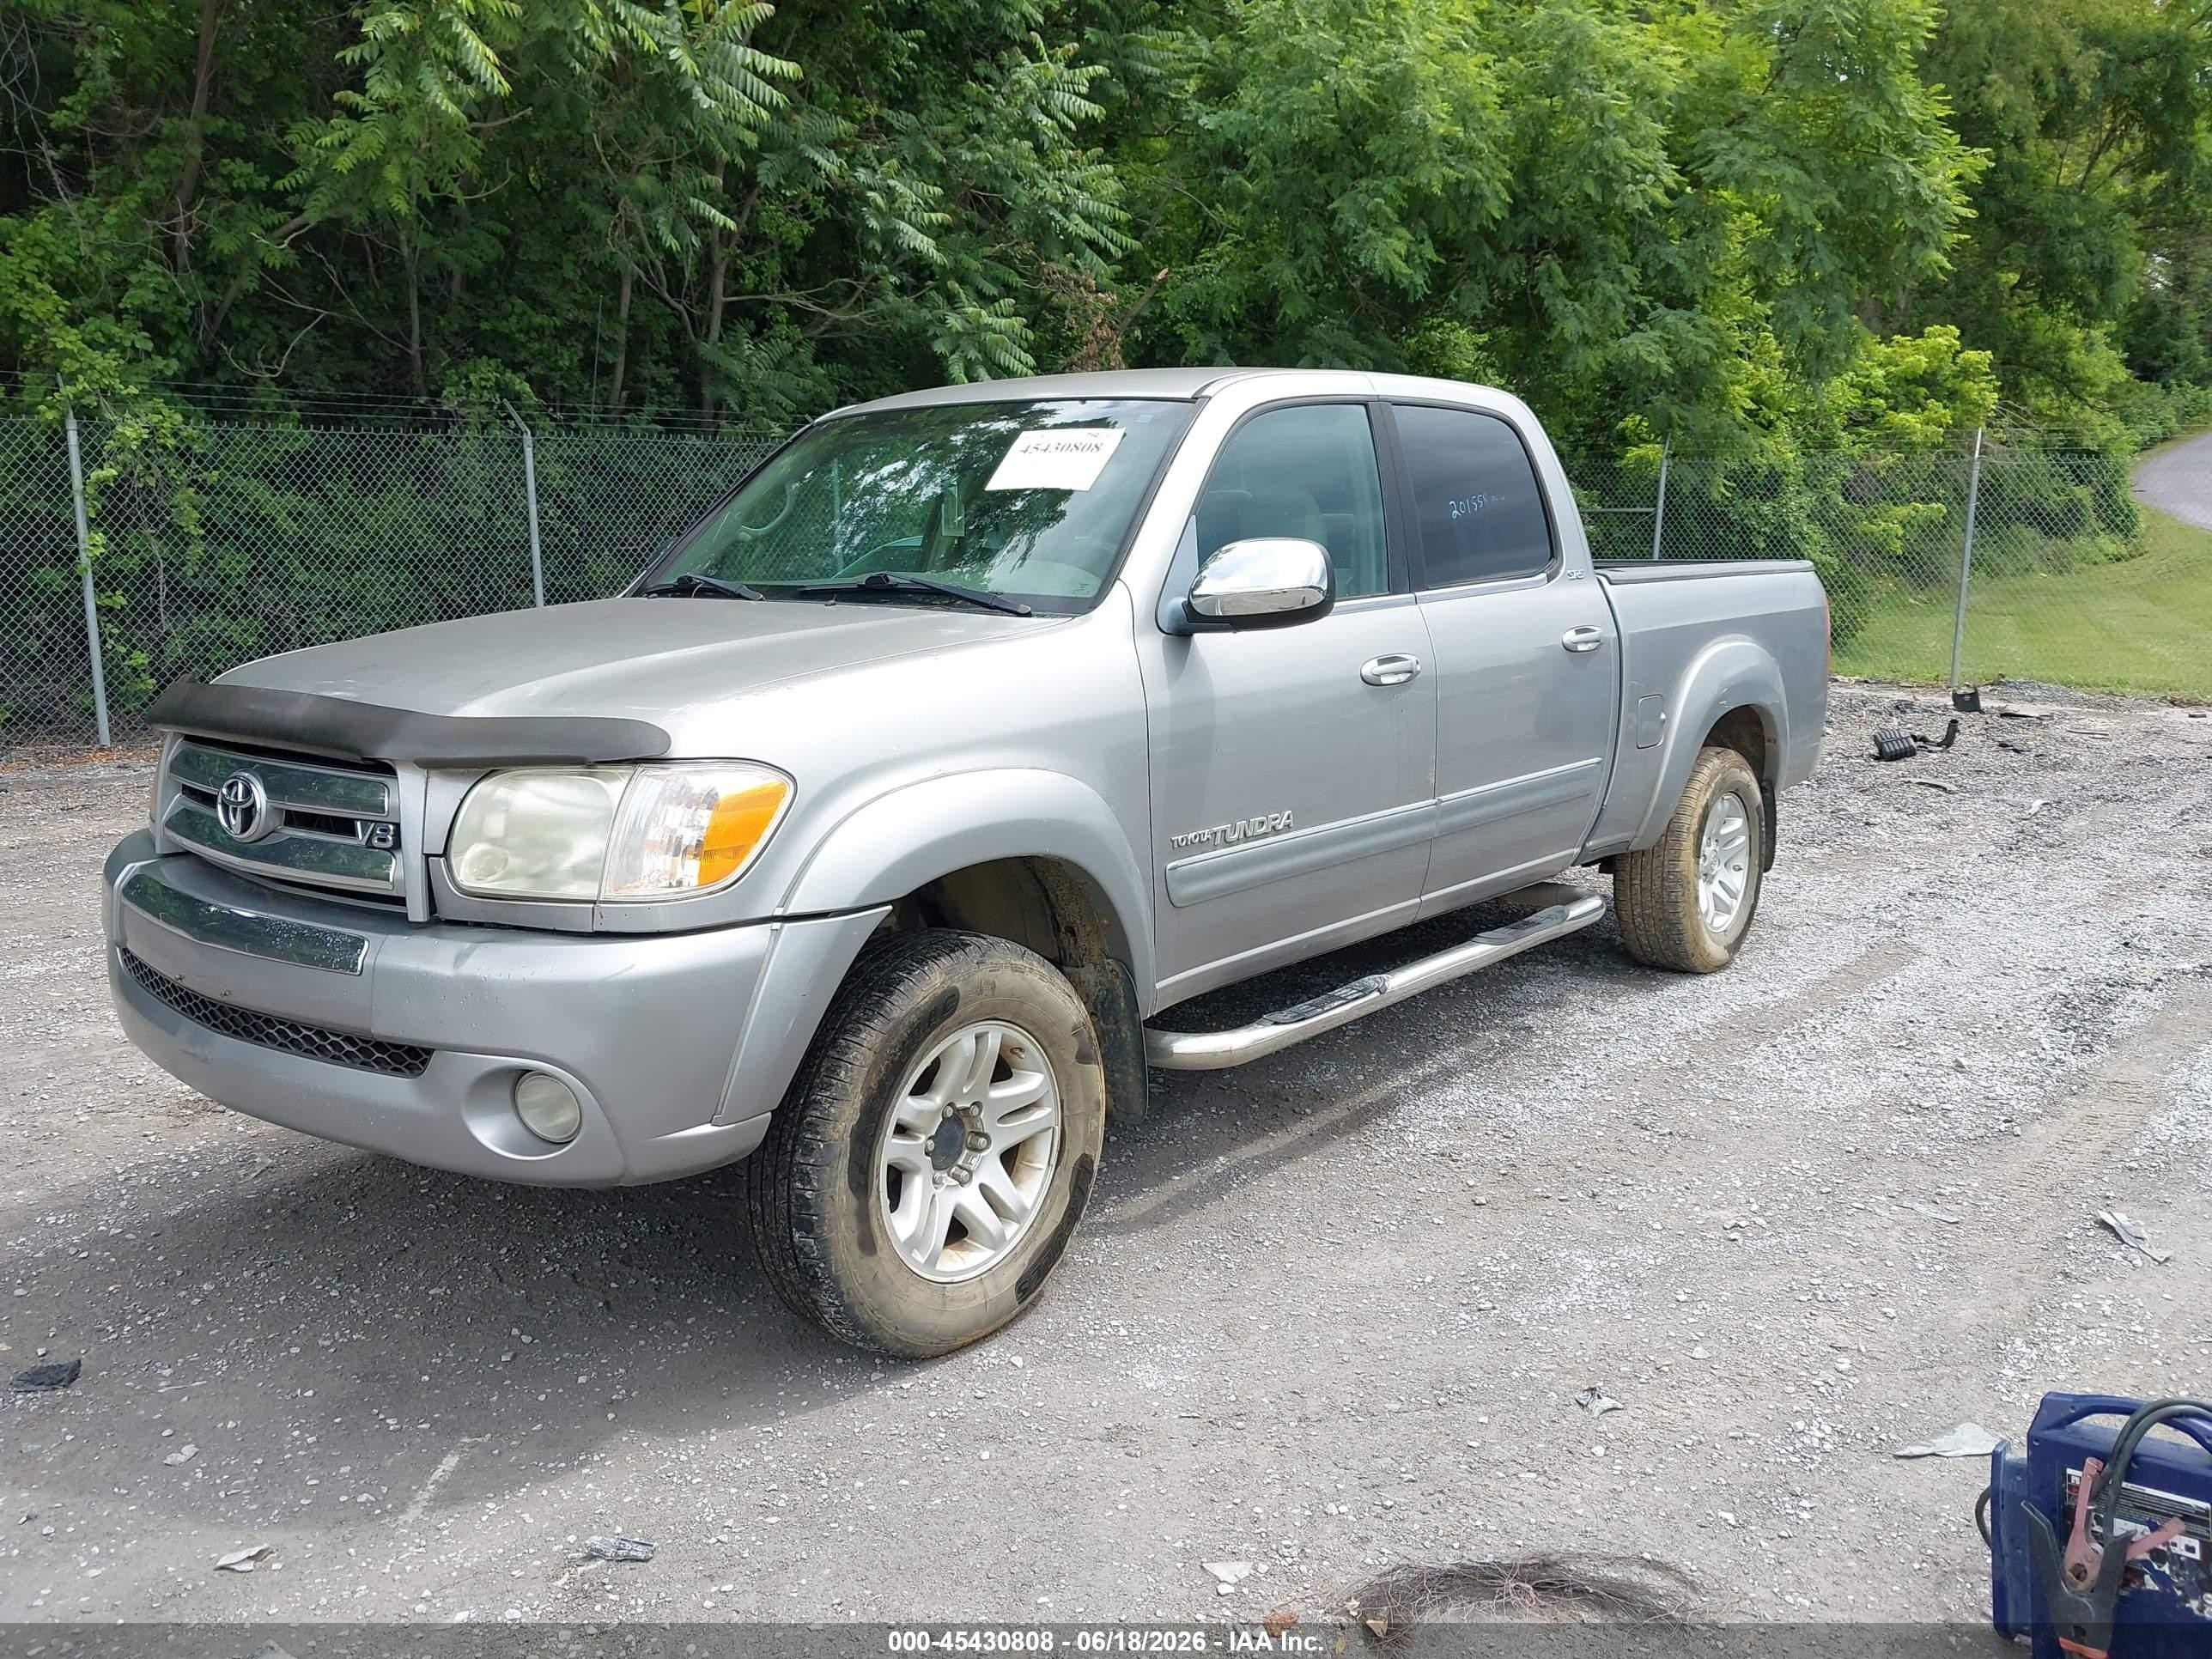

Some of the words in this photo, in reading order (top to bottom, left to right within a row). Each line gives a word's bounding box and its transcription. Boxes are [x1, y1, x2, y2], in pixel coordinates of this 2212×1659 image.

[1020, 442, 1103, 453] 45430808
[355, 820, 394, 848] V8
[1170, 829, 1212, 848] TOYOTA
[1210, 810, 1294, 846] TUNDRA
